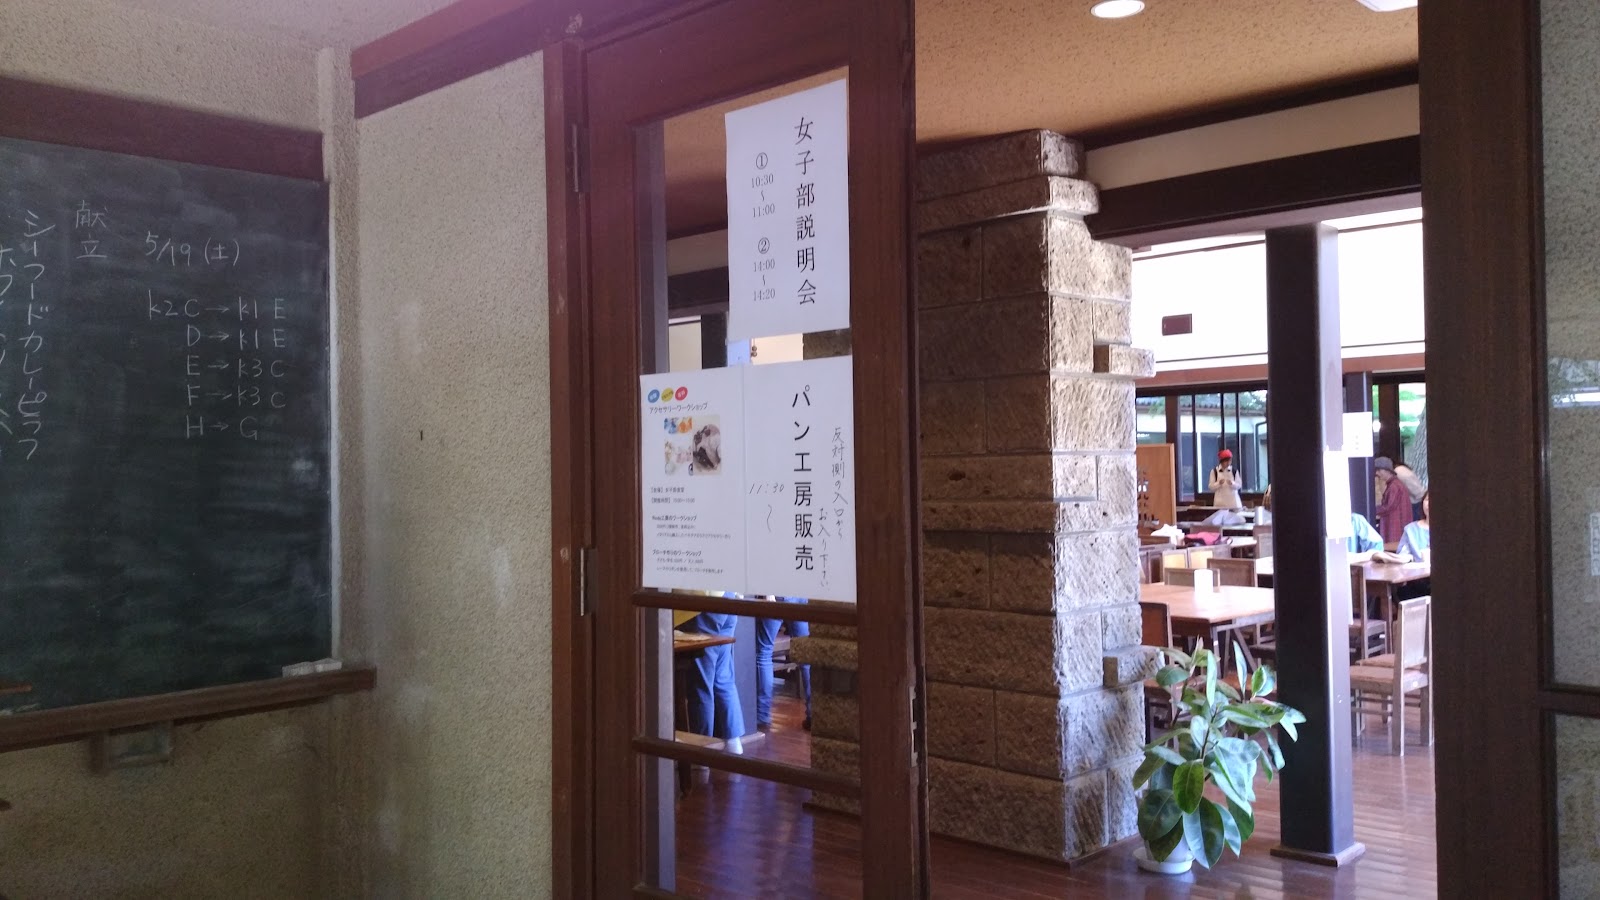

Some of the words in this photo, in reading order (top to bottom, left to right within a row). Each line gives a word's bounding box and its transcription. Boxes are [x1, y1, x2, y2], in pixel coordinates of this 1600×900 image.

[751, 174, 774, 188] 10:30
[752, 204, 776, 218] 11:00
[794, 116, 816, 305] 女子部説明会
[75, 199, 109, 259] 献立
[753, 259, 776, 273] 14:00
[753, 288, 776, 302] 14:20
[18, 209, 56, 461] シーフードカレーピラフ
[187, 323, 202, 347] D
[186, 354, 201, 376] E
[187, 383, 201, 406] F
[186, 414, 204, 440] H
[792, 384, 814, 571] パン工房販売
[831, 426, 849, 540] 反対側の入口から
